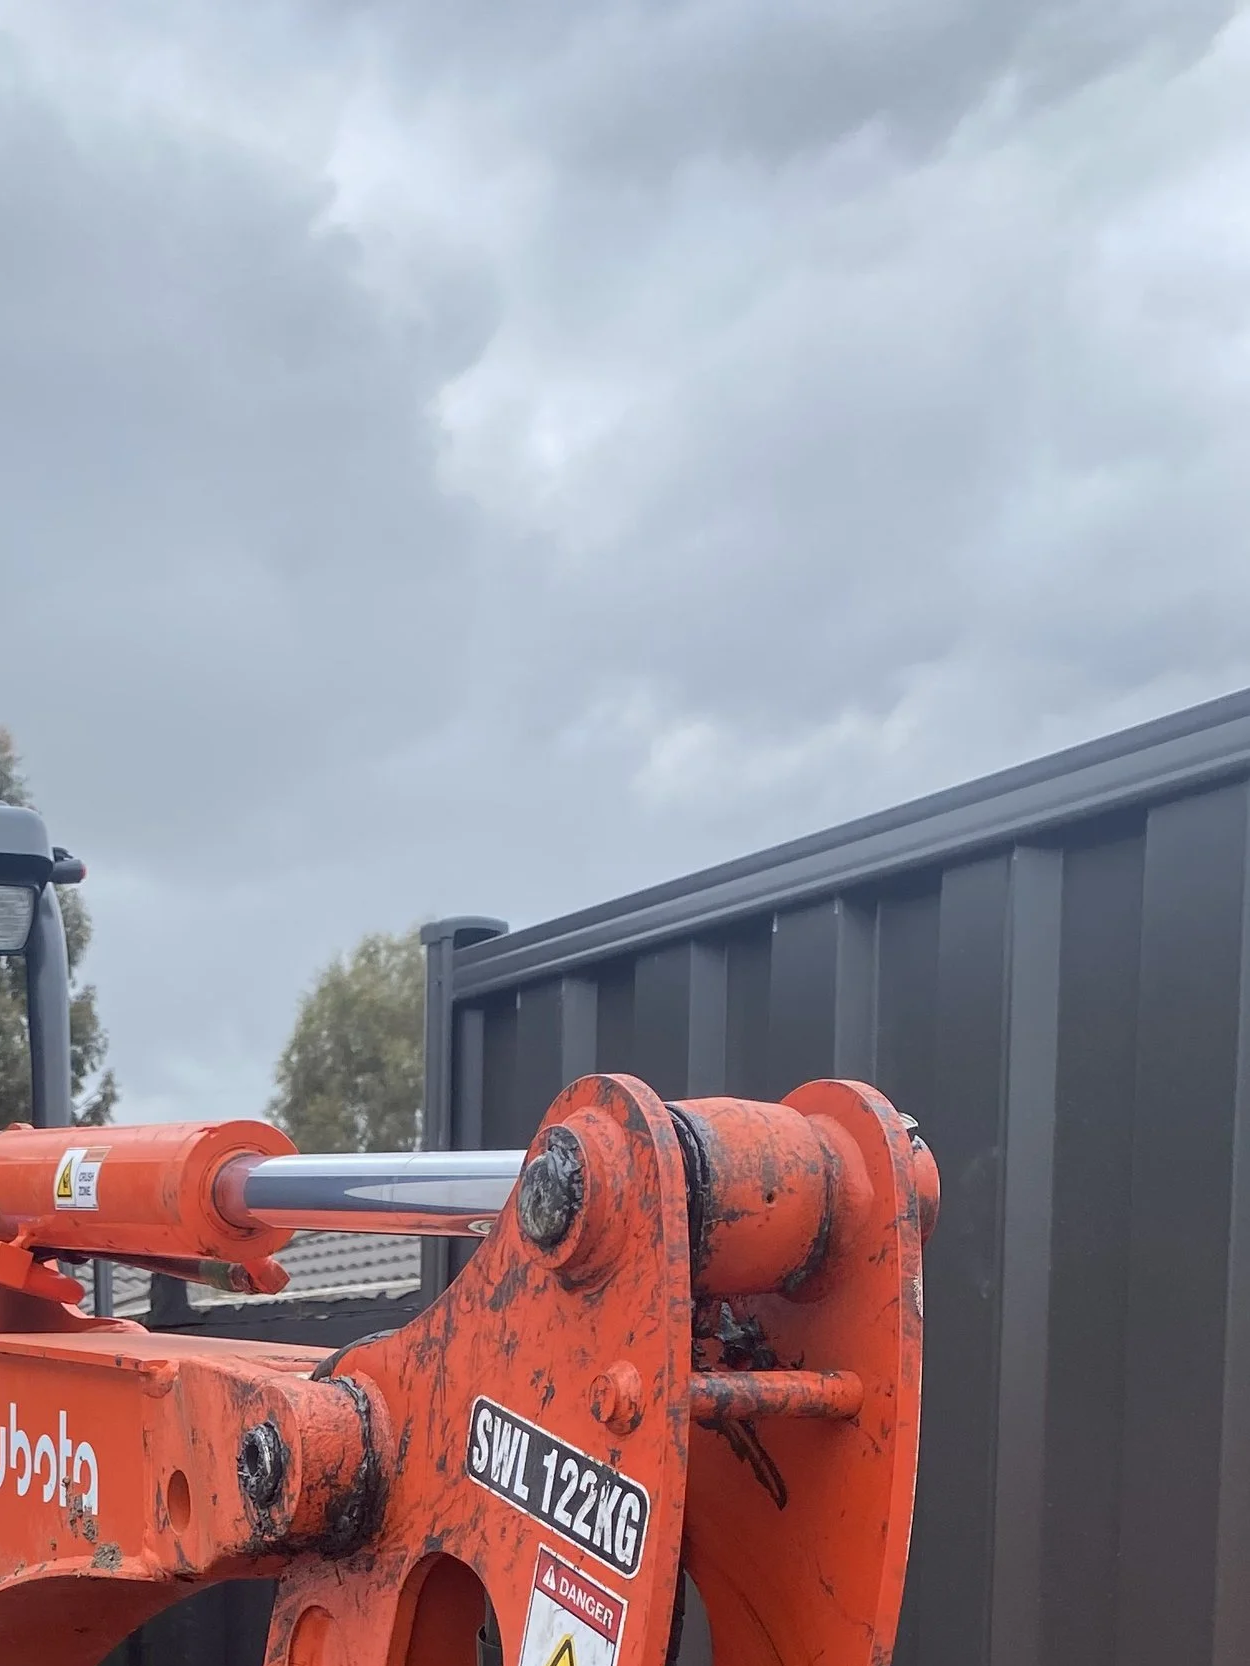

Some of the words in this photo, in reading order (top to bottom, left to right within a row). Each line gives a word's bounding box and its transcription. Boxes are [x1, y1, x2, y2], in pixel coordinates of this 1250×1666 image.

[471, 1406, 531, 1502] SWL
[541, 1447, 640, 1568] 122KG
[558, 1574, 614, 1631] DANGER
